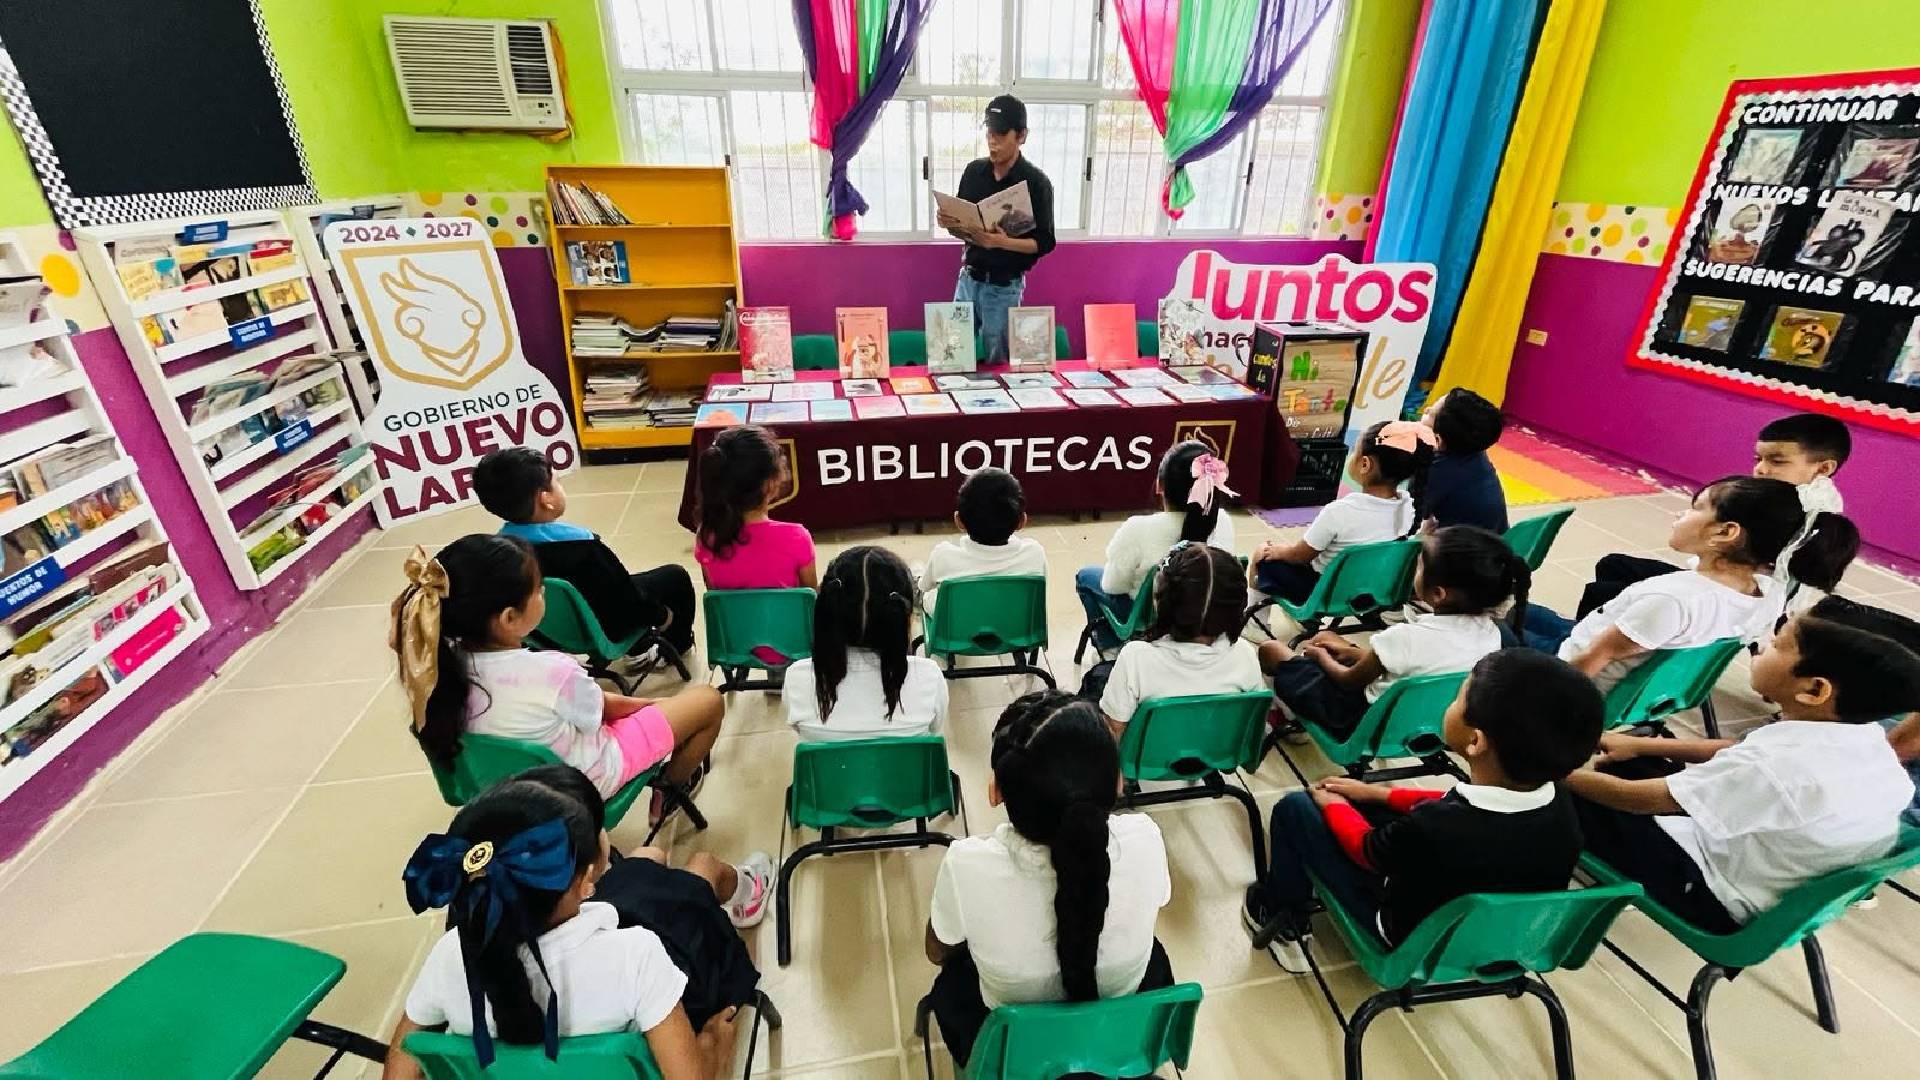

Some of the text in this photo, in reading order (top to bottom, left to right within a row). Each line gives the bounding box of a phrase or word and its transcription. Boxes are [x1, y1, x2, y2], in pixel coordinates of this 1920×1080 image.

[1743, 100, 1897, 124] CONTINUAR
[1714, 183, 1810, 205] NUEVOS
[339, 221, 473, 243] 2024 2027
[1684, 260, 1843, 297] SUGERENCIAS
[383, 384, 543, 433] GOBIERNO DE
[370, 402, 564, 480] NUEVO
[817, 436, 1153, 485] BIBLIOTECAS
